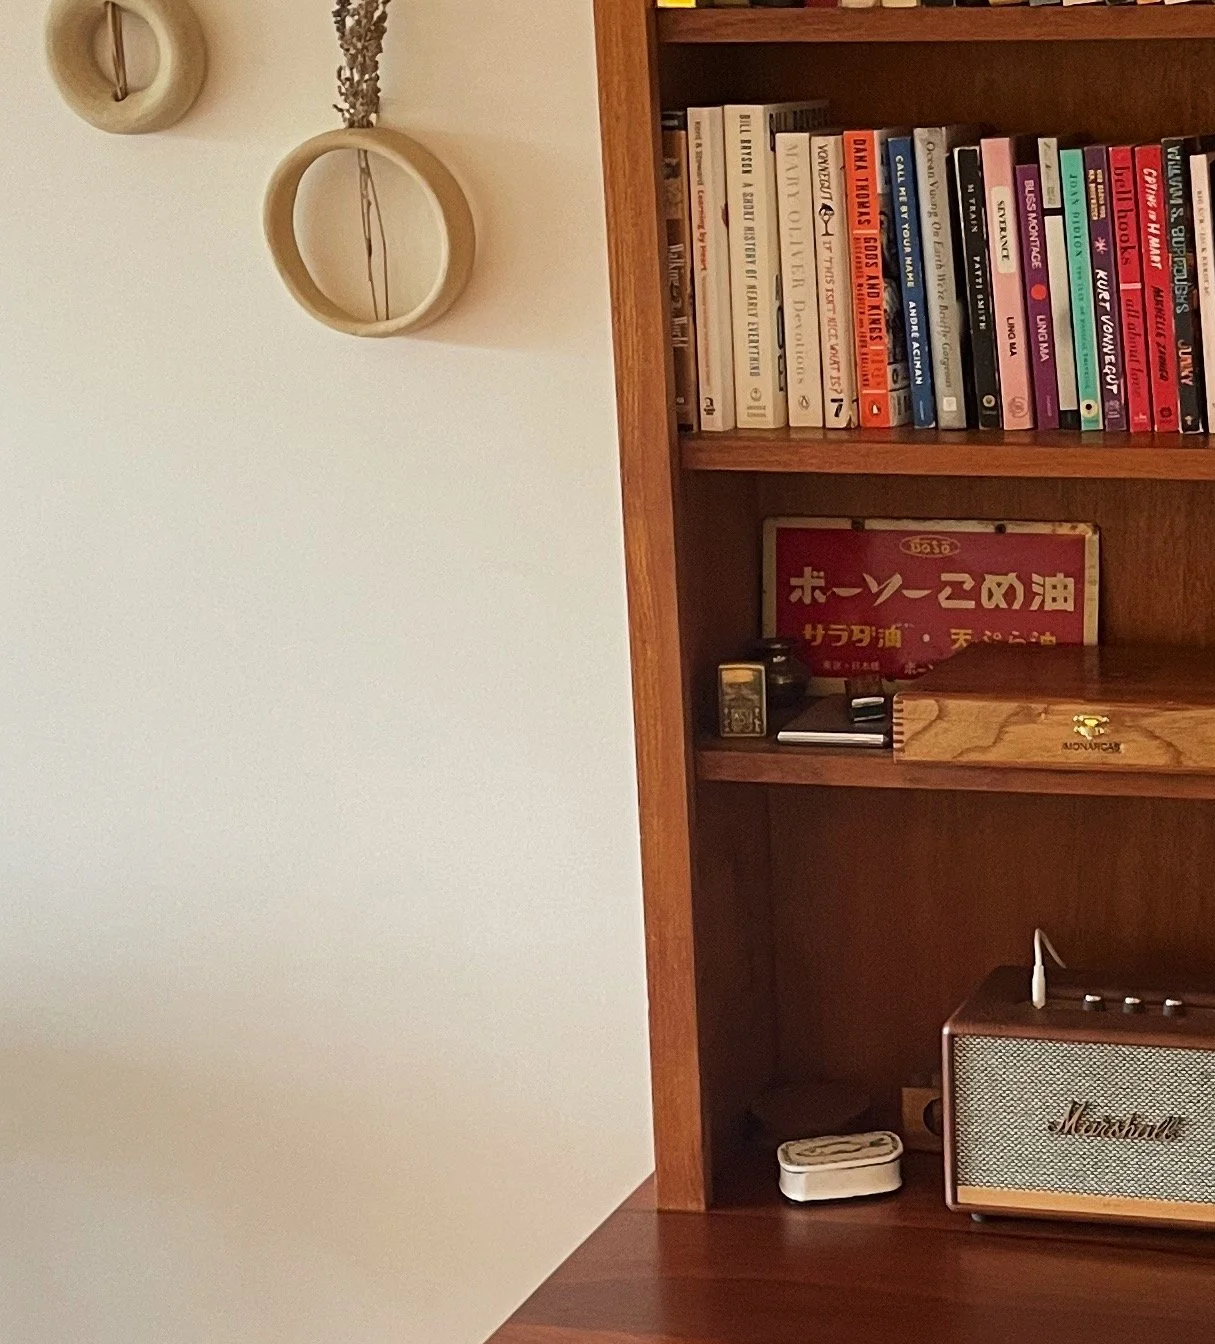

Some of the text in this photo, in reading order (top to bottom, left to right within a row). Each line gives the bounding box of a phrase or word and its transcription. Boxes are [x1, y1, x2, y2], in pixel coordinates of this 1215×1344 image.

[739, 114, 751, 135] BILL
[740, 139, 753, 175] BRYSON
[852, 138, 869, 171] DANA
[742, 192, 755, 222] SHORT
[855, 178, 872, 226] THOMAS
[744, 226, 757, 266] HISTORY
[784, 142, 808, 386] MARY OLIVER Devotions
[863, 236, 880, 269] GODS
[745, 269, 757, 280] OF
[866, 274, 880, 298] AND
[895, 155, 923, 384] CALL ME BY YOUR NAME ANDRÉ ACIMAN
[997, 200, 1018, 356] SEVERANCE LING MA
[1024, 179, 1050, 362] BLISS MONTAGE LING MA
[1112, 166, 1144, 397] bell hooks all about love
[746, 284, 758, 318] NEARLY
[868, 305, 883, 342] KINGS
[1095, 269, 1118, 394] KURT VONNEGUT
[748, 322, 760, 377] EVERYTHING
[789, 566, 1075, 612] ボーソーこめ油
[802, 623, 903, 649] サラダ油
[1048, 1099, 1186, 1142] Marshall
